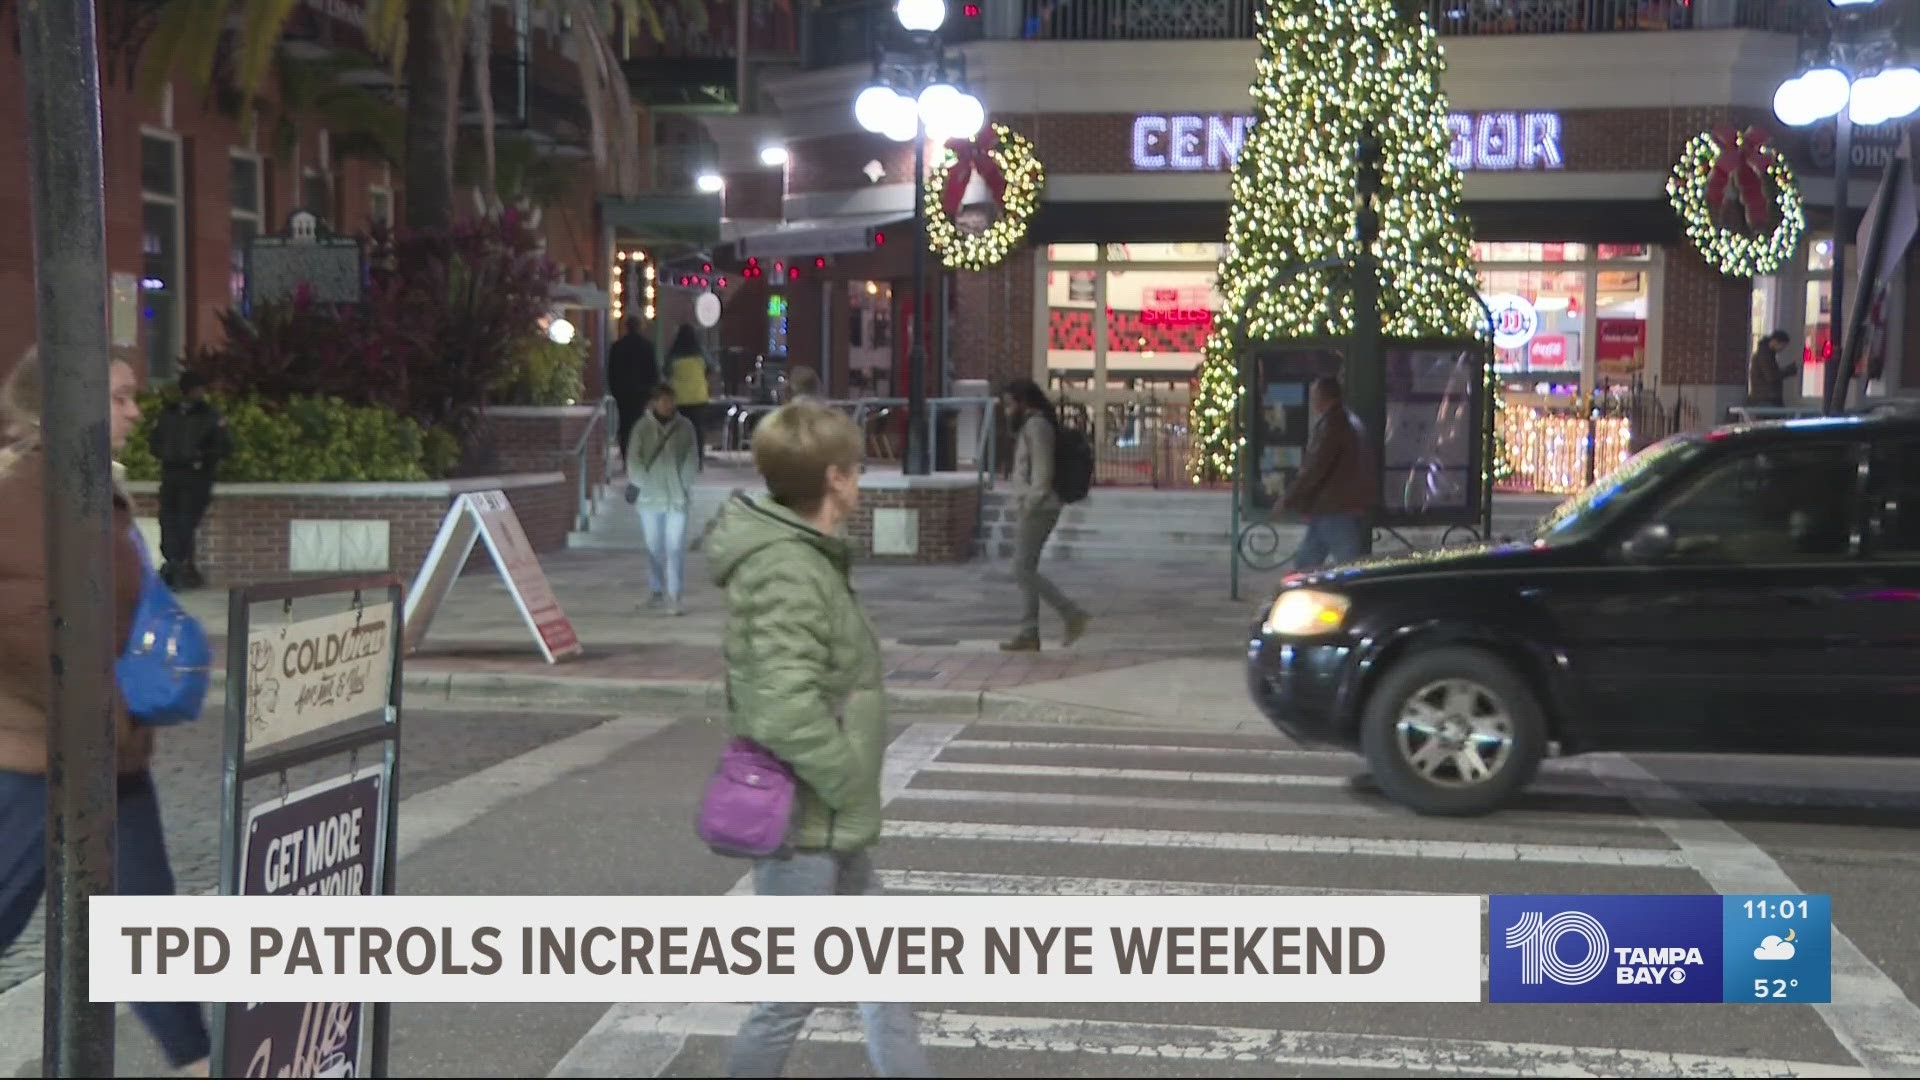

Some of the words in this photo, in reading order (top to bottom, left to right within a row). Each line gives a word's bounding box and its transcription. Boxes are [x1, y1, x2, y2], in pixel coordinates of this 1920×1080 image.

[1134, 115, 1258, 168] CEN
[1443, 113, 1563, 168] BOR
[1144, 308, 1209, 321] SMELLS
[283, 633, 339, 678] COLD
[264, 829, 304, 893] GET
[305, 807, 363, 876] MORE
